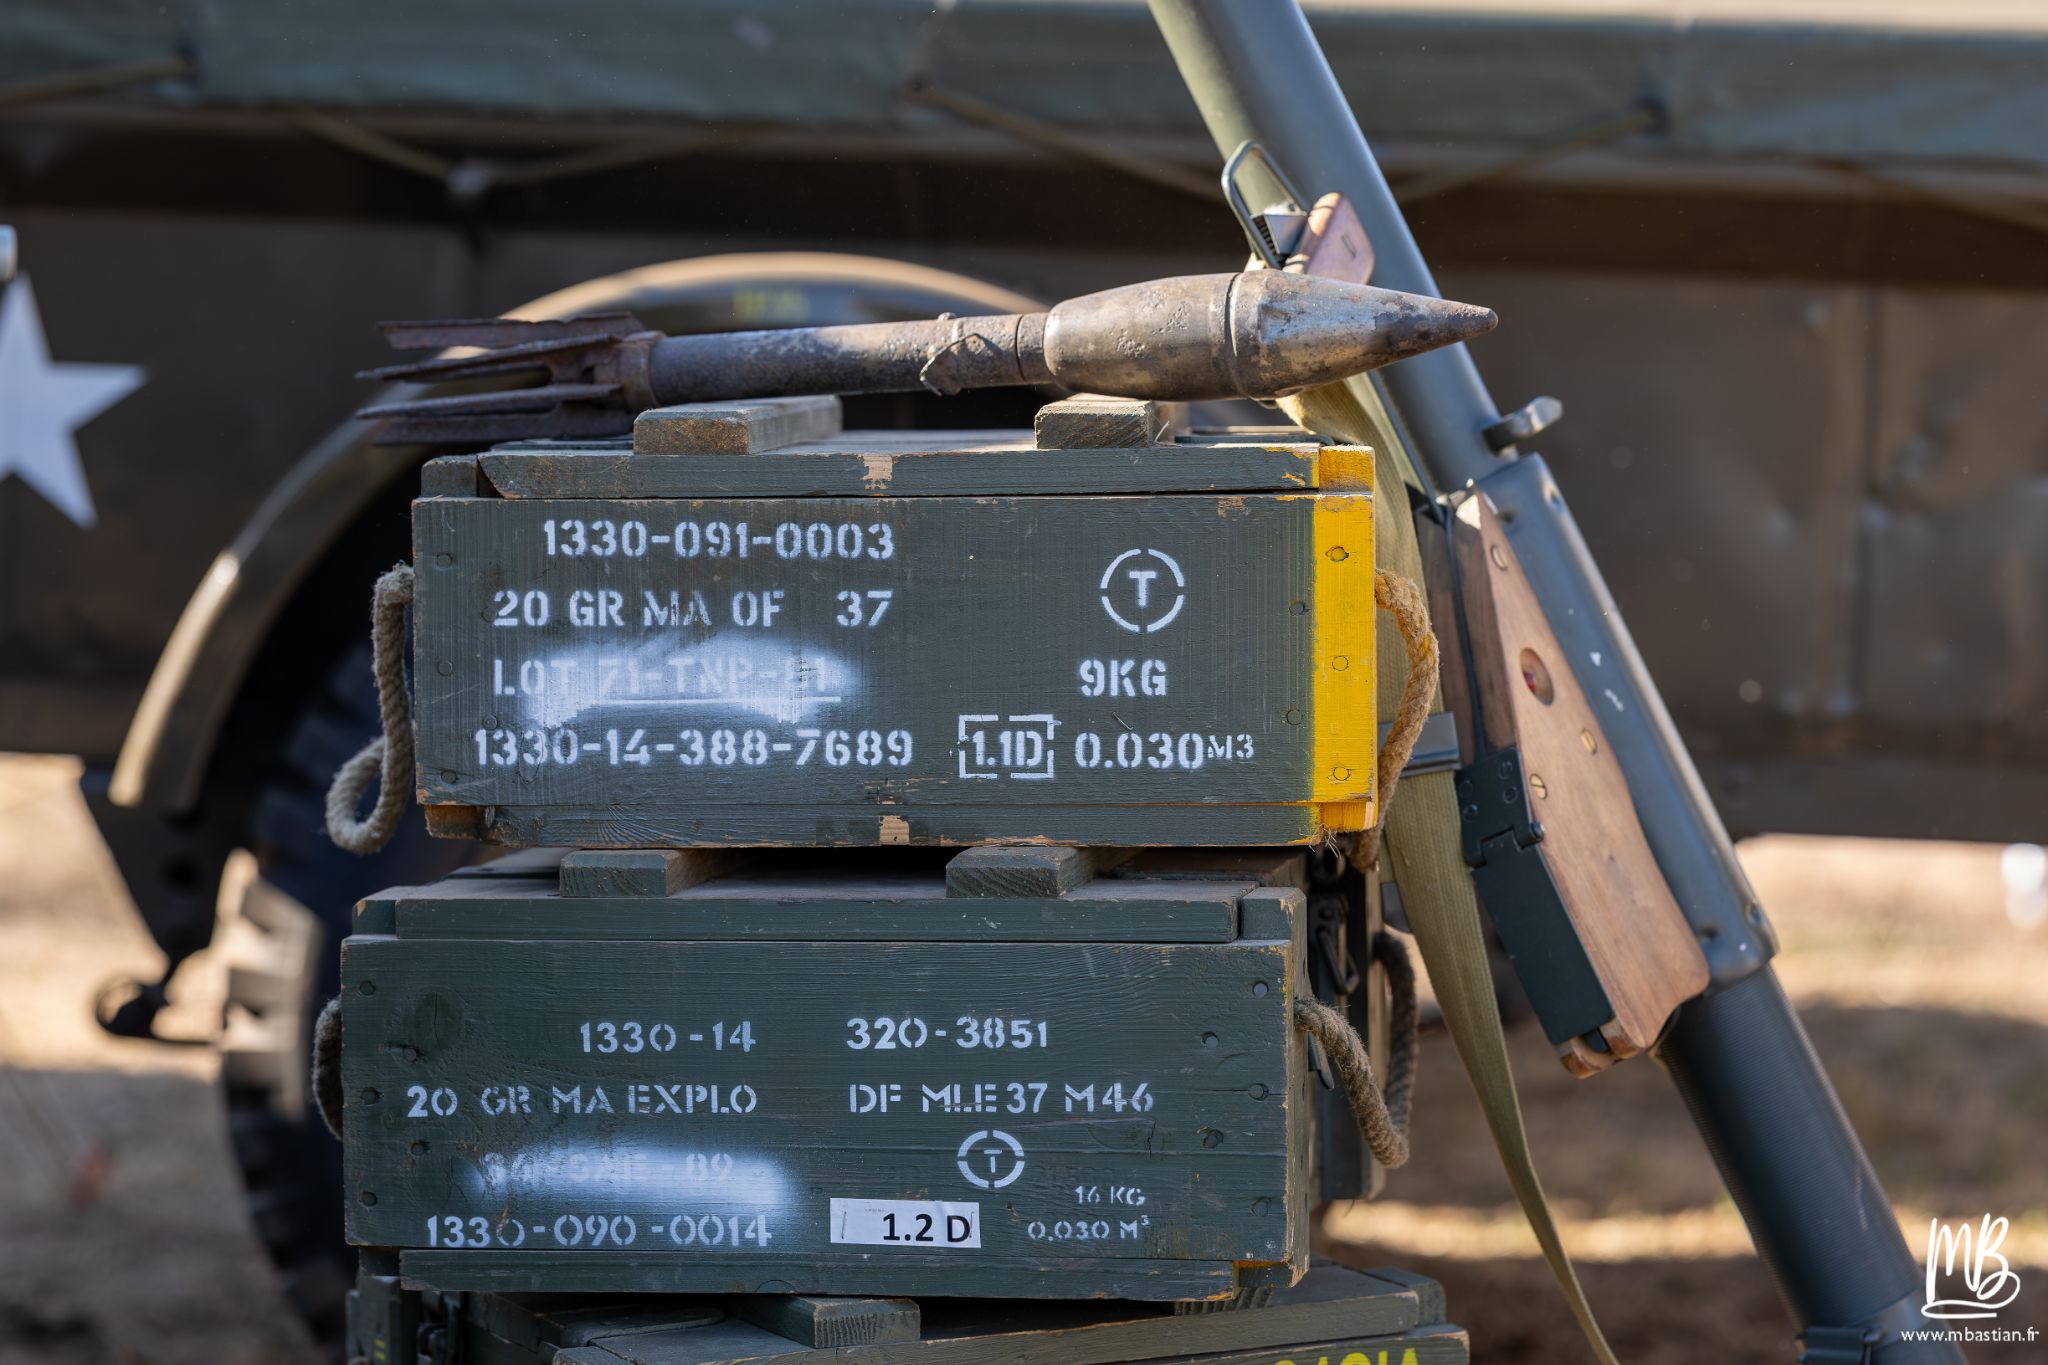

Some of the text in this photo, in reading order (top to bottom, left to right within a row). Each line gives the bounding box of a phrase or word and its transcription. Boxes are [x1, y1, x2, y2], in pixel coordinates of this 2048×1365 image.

[543, 519, 895, 560] 1330-091-0003
[493, 589, 893, 628] 20 GR MA OF 37
[494, 658, 578, 694] LOT
[1078, 659, 1167, 697] 9KG
[475, 727, 913, 766] 1330-14-388-7689
[406, 1084, 758, 1118] 20 GR MA EXPLO
[849, 1083, 902, 1114] DF
[1064, 1082, 1154, 1113] M46
[1074, 1185, 1146, 1206] 16 KG
[882, 1213, 970, 1242] 1.2 D
[1027, 1220, 1110, 1242] 0.030
